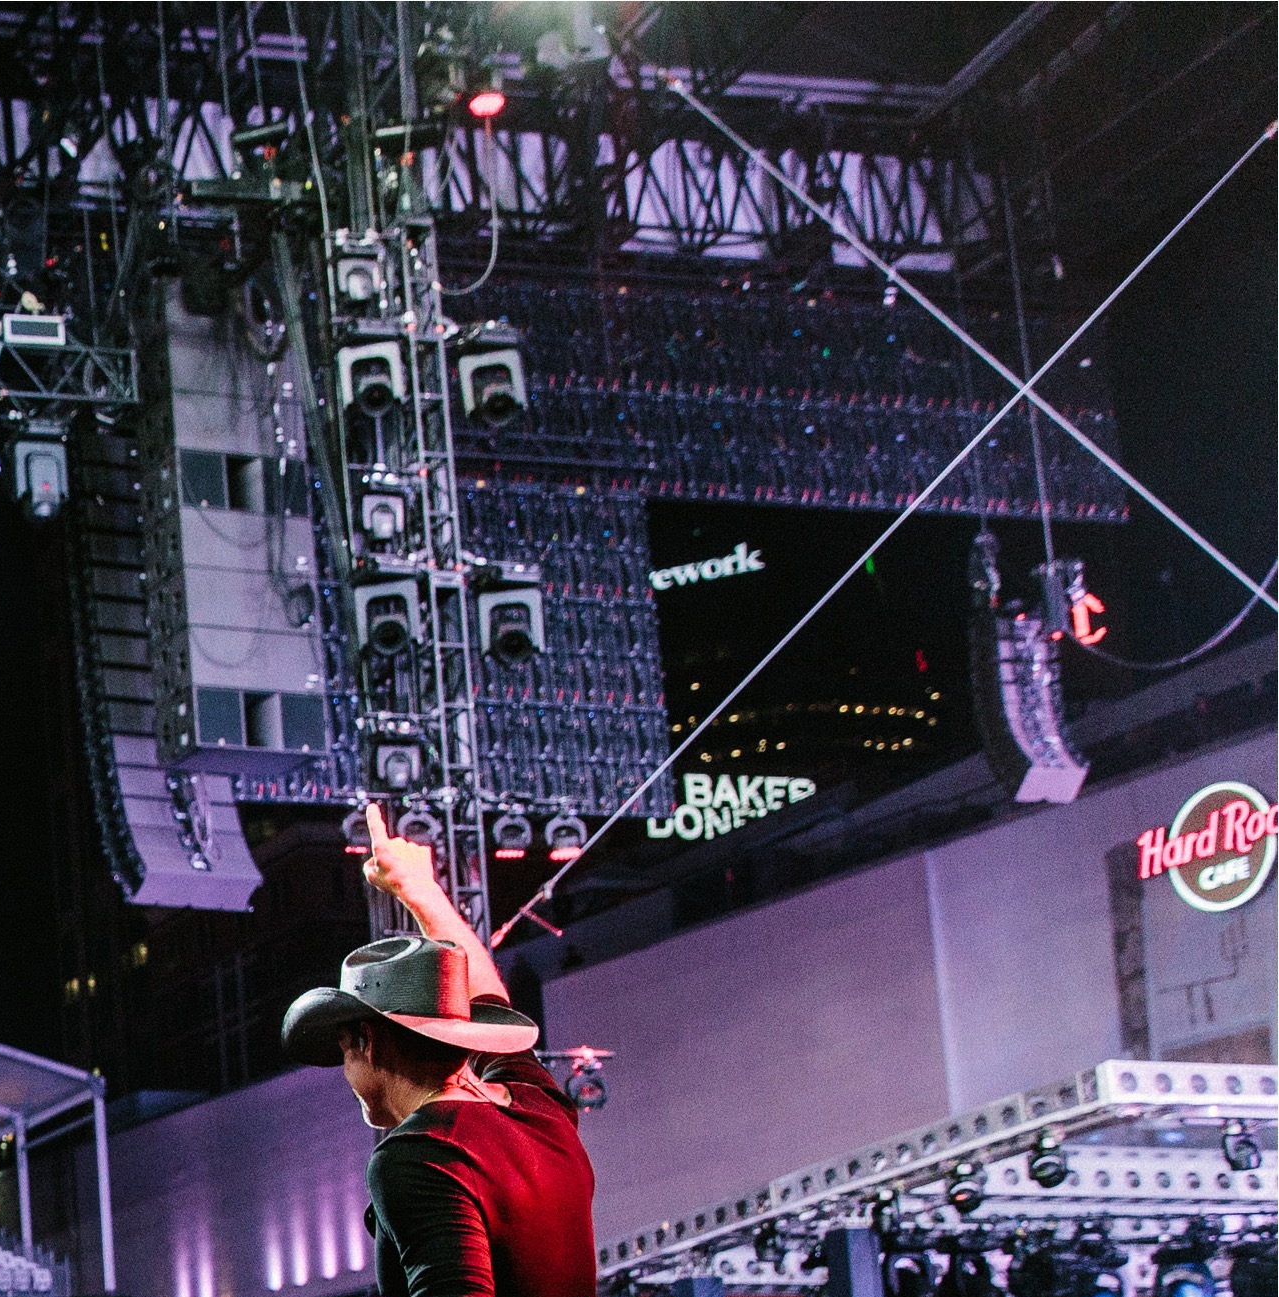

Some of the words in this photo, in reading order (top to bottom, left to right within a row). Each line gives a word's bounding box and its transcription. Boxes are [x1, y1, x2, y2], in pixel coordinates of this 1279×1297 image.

[648, 541, 766, 591] ework
[1137, 810, 1220, 879] Hard
[1221, 800, 1278, 853] Roc
[1198, 855, 1251, 890] CAFE
